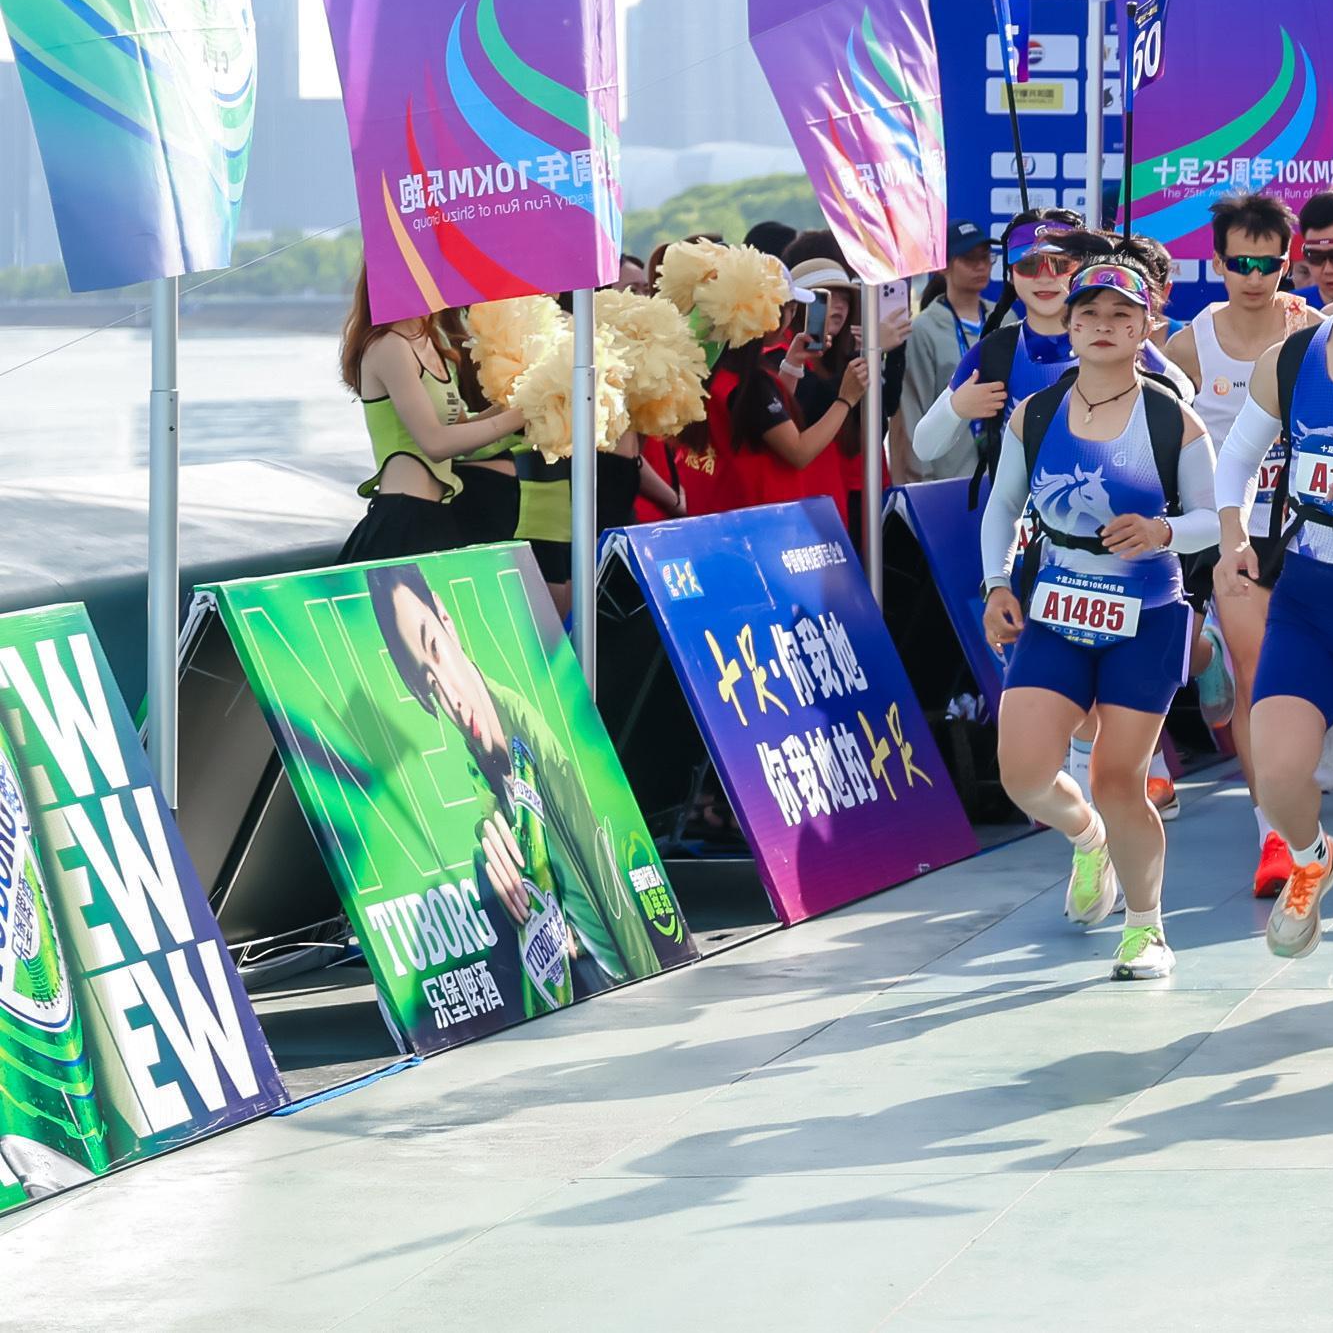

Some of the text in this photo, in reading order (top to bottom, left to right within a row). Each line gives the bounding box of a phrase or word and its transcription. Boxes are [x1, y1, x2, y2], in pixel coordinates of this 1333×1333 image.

[1042, 591, 1125, 632] A1485
[365, 878, 498, 978] TUBORG
[422, 960, 504, 1029] 乐堡啤酒
